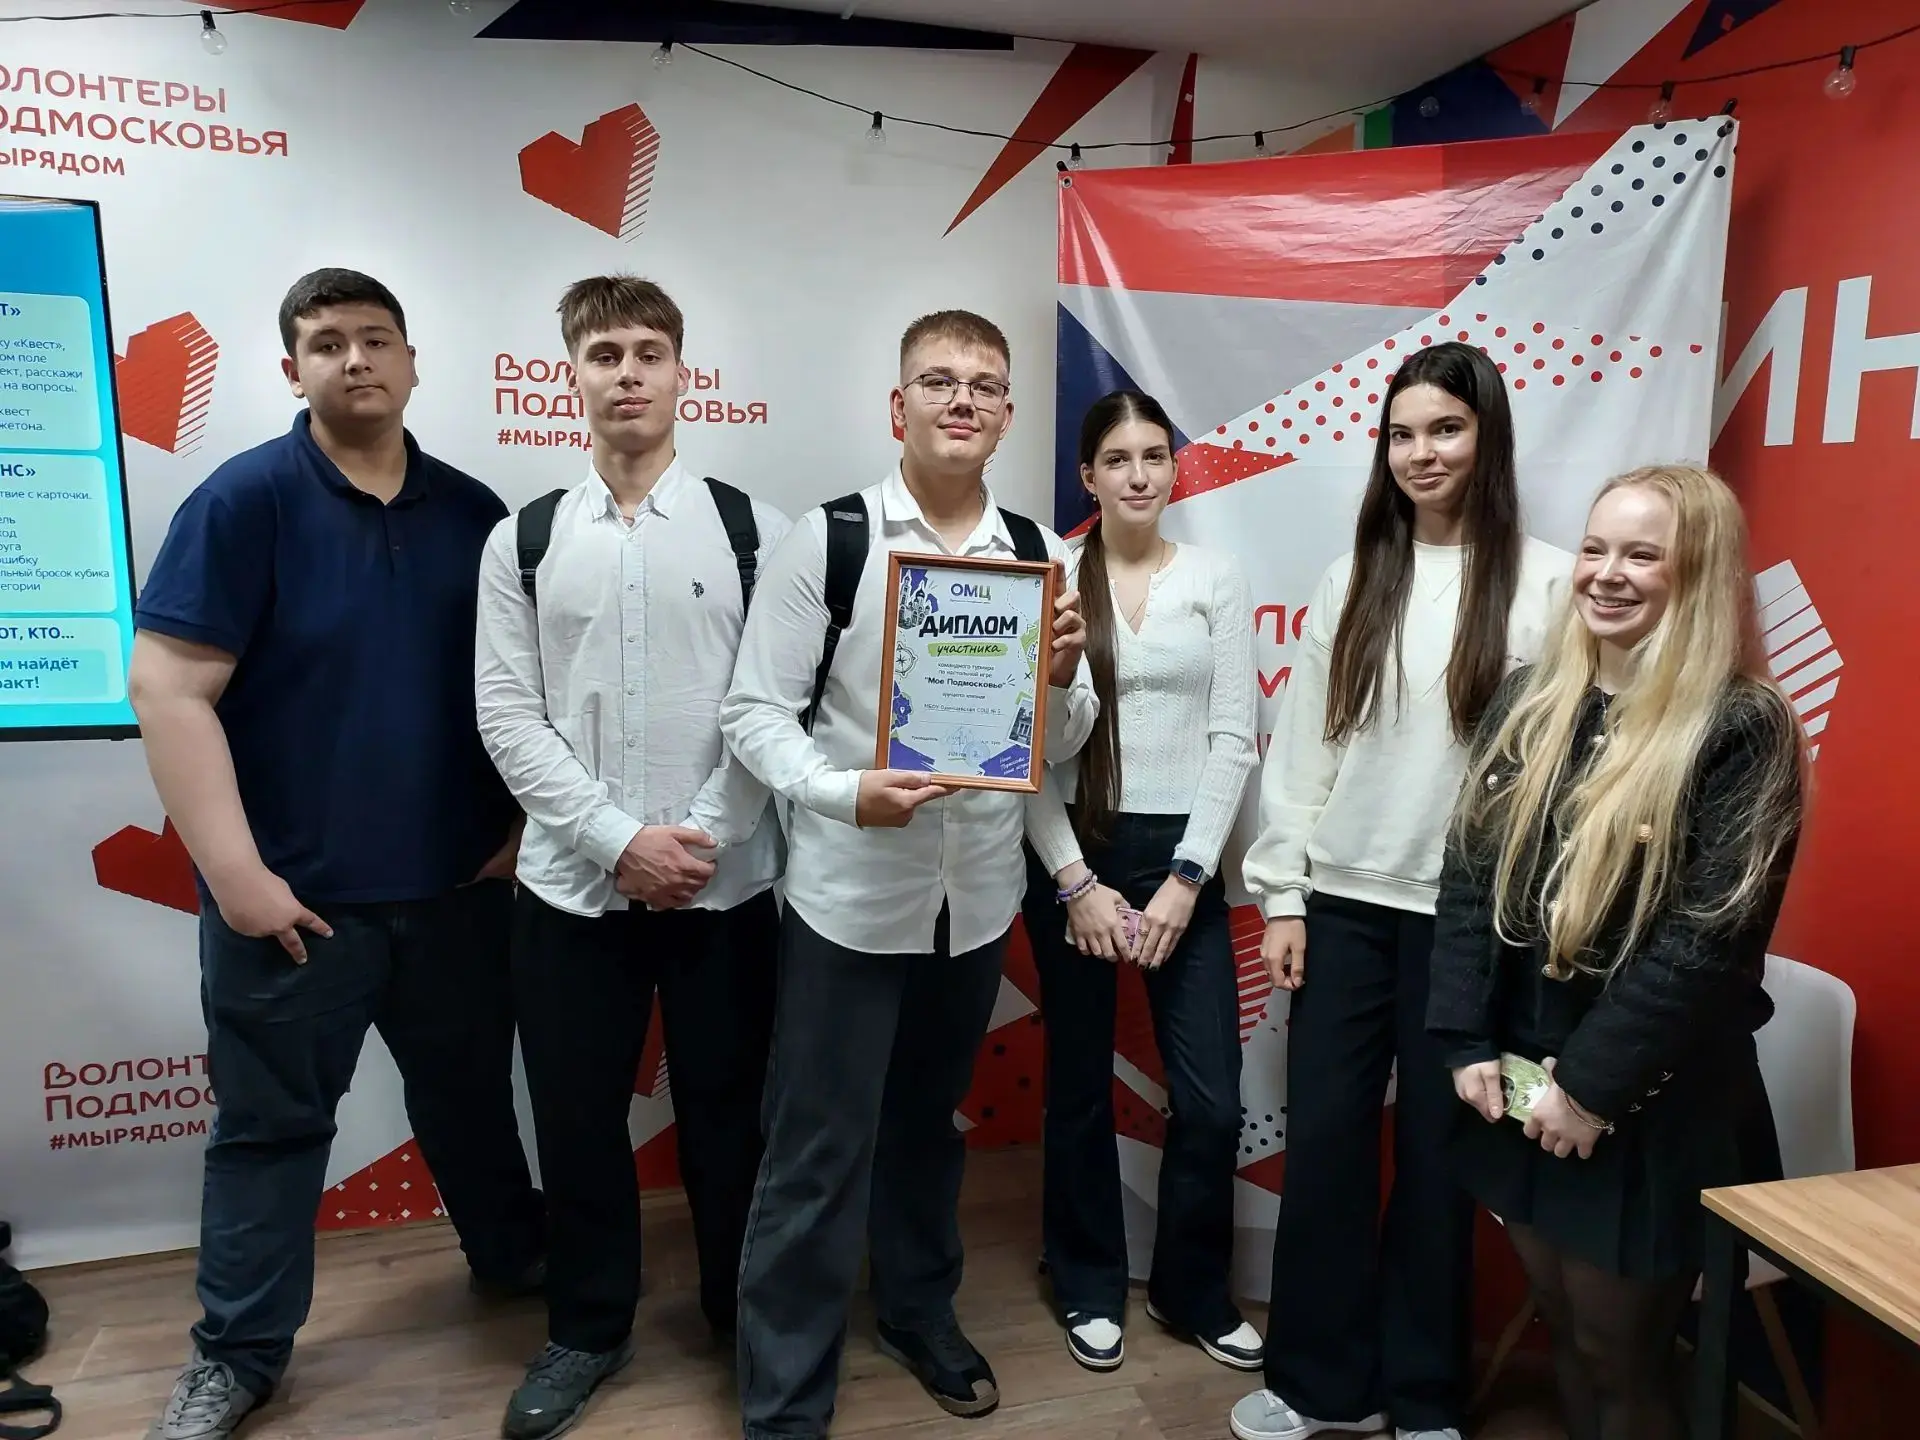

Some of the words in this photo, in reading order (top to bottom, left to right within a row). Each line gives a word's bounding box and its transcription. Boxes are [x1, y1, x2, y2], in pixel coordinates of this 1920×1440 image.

[14, 339, 65, 351] «Квест»,
[19, 354, 47, 363] поле
[26, 368, 83, 378] расскажи
[4, 382, 18, 390] на
[22, 383, 77, 393] вопросы.
[497, 429, 592, 451] #МЫРЯ
[37, 491, 92, 500] карточки.
[0, 530, 17, 538] од
[0, 555, 38, 566] шибку
[36, 568, 72, 579] бросок
[75, 568, 109, 579] кубика
[950, 583, 991, 601] ОМЦ
[919, 615, 1018, 638] ДИПЛОМ
[28, 627, 74, 639] КТО...
[937, 643, 1001, 657] участника
[18, 657, 79, 671] найдёт
[0, 676, 39, 689] акт!
[44, 1054, 209, 1089] ВОЛОНТ
[50, 1119, 207, 1150] #МЫРЯДОМ
